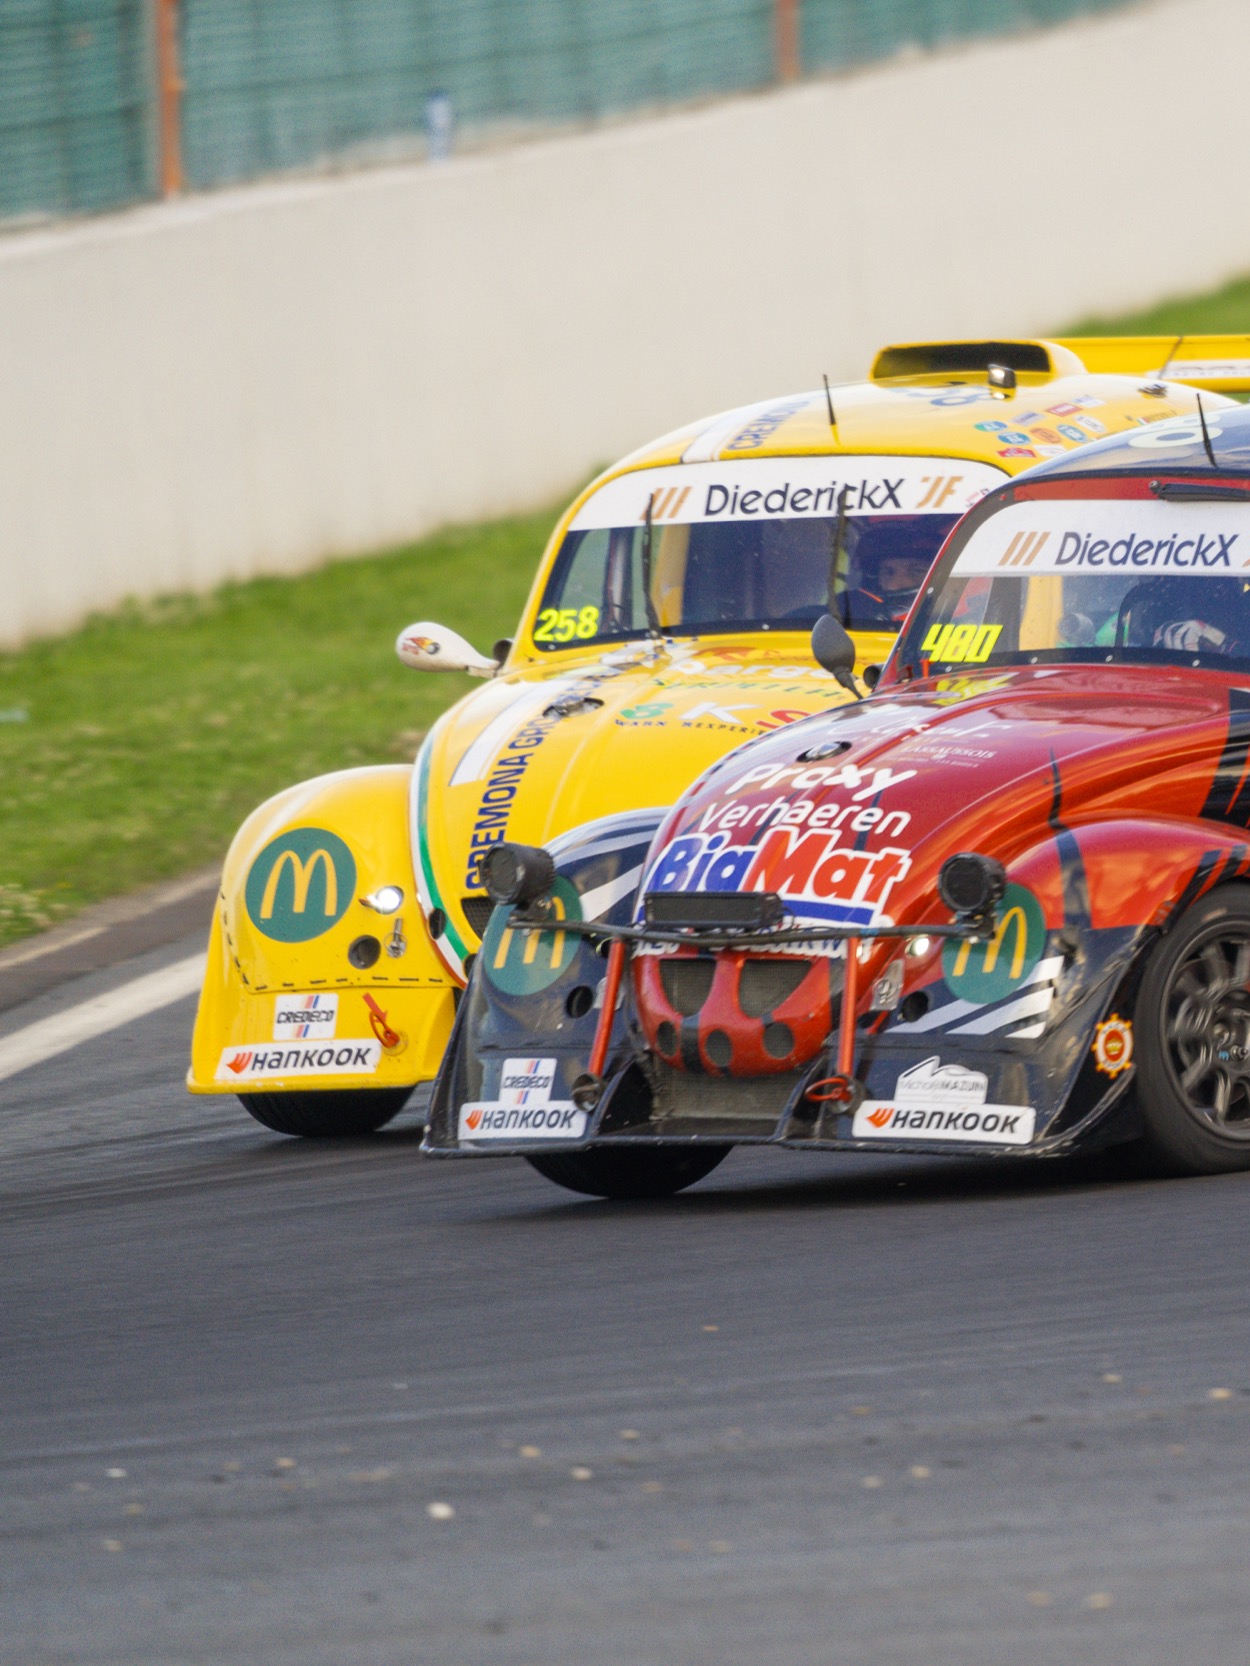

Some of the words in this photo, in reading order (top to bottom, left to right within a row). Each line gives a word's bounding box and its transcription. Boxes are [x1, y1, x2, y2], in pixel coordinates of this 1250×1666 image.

[704, 479, 904, 517] DiederickX
[1054, 531, 1239, 567] DiederickX
[534, 605, 599, 642] 258
[921, 624, 1004, 663] 480
[725, 763, 918, 801] Proxy
[698, 795, 912, 838] Verhaeren
